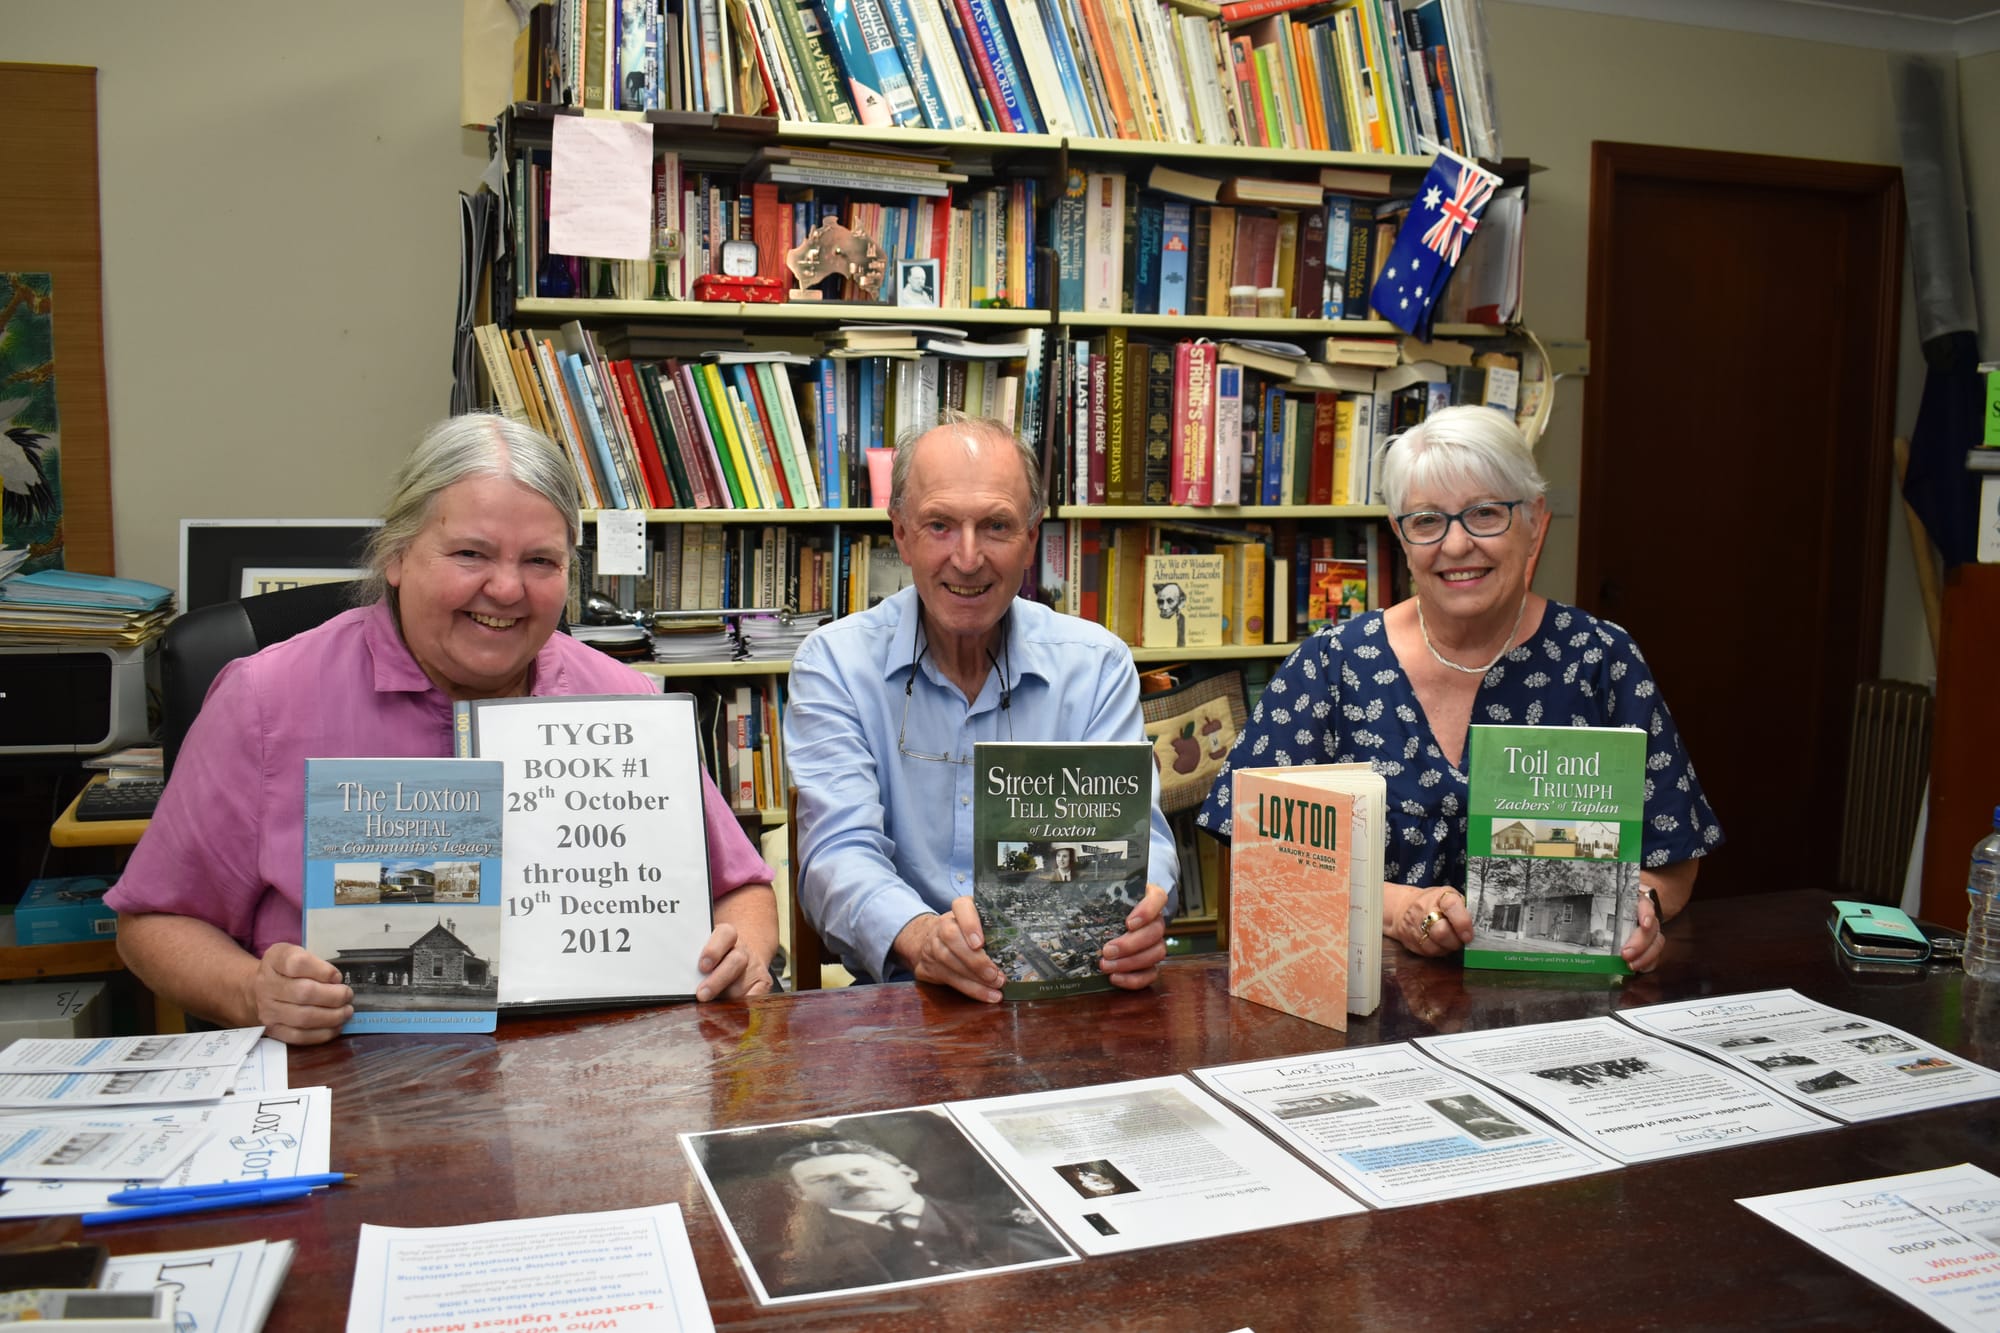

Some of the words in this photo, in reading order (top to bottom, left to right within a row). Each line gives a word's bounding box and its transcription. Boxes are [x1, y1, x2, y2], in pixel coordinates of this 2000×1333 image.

[969, 0, 985, 22] LAS
[853, 0, 882, 51] Australia
[866, 0, 892, 48] ronicle
[897, 24, 913, 40] of
[979, 24, 989, 36] OF
[983, 35, 996, 55] THE
[805, 36, 840, 103] EVENTS
[900, 36, 935, 97] Australian
[990, 58, 1016, 108] WORLD
[922, 95, 945, 127] Birds
[1060, 200, 1075, 279] Encyclopedia
[1092, 361, 1106, 404] Mysteries
[1113, 335, 1123, 409] AUSTRALIA'S
[1078, 364, 1088, 405] ATLAS
[1186, 347, 1205, 420] STRONG'S
[1093, 405, 1105, 413] of
[1095, 414, 1106, 429] the
[1184, 424, 1192, 435] OF
[1095, 431, 1105, 453] Bible
[1111, 412, 1121, 481] YESTERDAYS
[1183, 437, 1191, 452] THE
[1188, 421, 1199, 480] CONCORDANCE
[1154, 570, 1190, 580] Abraham
[1192, 568, 1220, 580] Lincoln
[1188, 558, 1212, 568] Wisdom
[1315, 563, 1327, 573] 101
[457, 713, 469, 731] 100
[538, 722, 634, 746] TYGB
[524, 758, 616, 779] BOOK
[622, 758, 650, 778] #1
[1504, 747, 1548, 774] Toil
[1556, 752, 1600, 776] and
[988, 766, 1054, 796] Street
[1061, 767, 1139, 796] Names
[1529, 776, 1613, 800] TRIUMPH
[337, 782, 387, 812] The
[396, 782, 480, 812] Loxton
[508, 785, 556, 812] 28th
[564, 790, 669, 810] October
[1006, 797, 1048, 818] TELL
[1054, 796, 1121, 818] STORIES
[1558, 802, 1567, 812] of
[1571, 801, 1619, 815] Taplan
[366, 814, 452, 838] HOSPITAL
[1030, 824, 1040, 836] of
[1043, 824, 1096, 837] Loxton
[1258, 792, 1336, 852] LOXTON
[556, 824, 626, 848] 2006
[343, 841, 438, 856] Community's
[443, 842, 492, 856] Legacy
[1278, 846, 1306, 858] MARJORY
[1312, 854, 1336, 864] CASSON
[524, 862, 629, 888] through
[638, 863, 662, 882] to
[1319, 862, 1336, 872] HIRST
[507, 890, 551, 917] 19th
[560, 895, 680, 915] December
[561, 928, 632, 954] 2012
[1604, 1122, 1644, 1134] Adelaide
[1658, 1116, 1681, 1125] Bank
[1681, 1113, 1699, 1121] The
[1888, 1240, 1936, 1254] DROP
[1938, 1236, 1961, 1246] IN
[1926, 1256, 1968, 1268] Who
[472, 1311, 552, 1329] Ugliest
